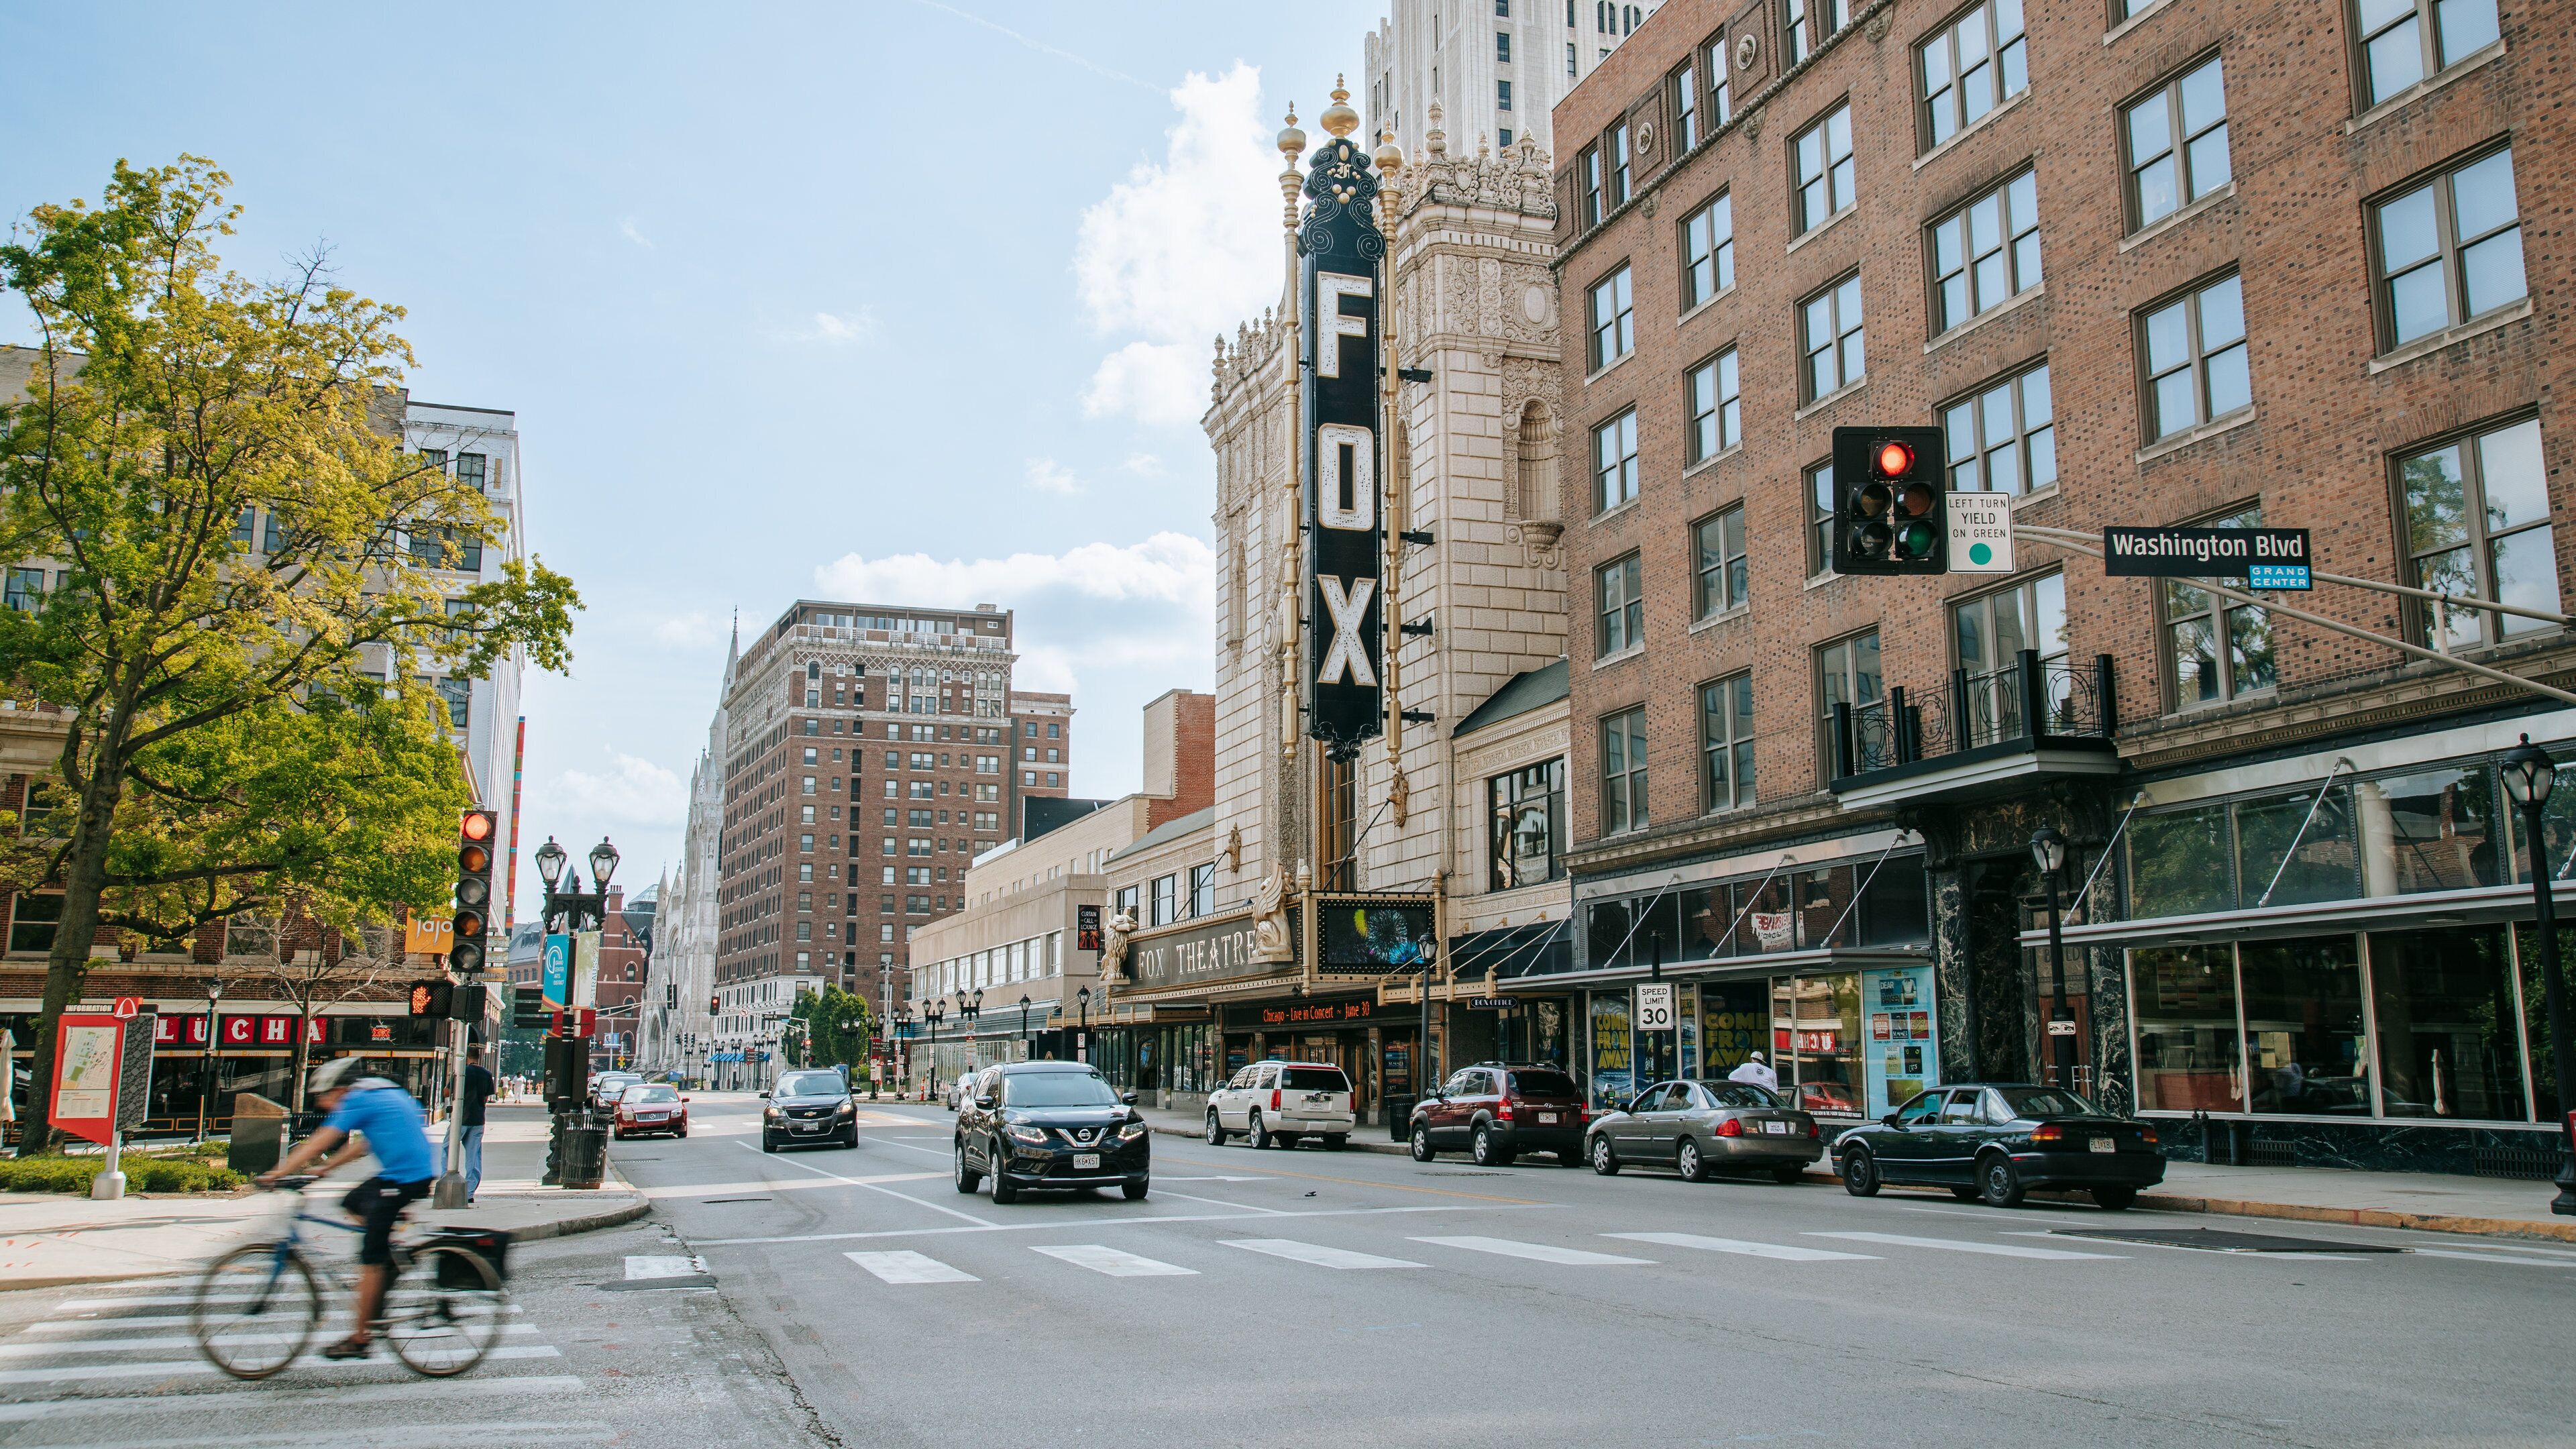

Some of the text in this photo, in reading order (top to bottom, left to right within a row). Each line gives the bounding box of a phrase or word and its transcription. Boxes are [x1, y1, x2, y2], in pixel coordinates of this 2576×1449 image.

[1316, 272, 1377, 687] FOX
[1949, 499, 2006, 508] LEFT TURN
[1961, 513, 1996, 524] YIELD
[1953, 529, 2006, 537] ON GREEN
[2112, 533, 2302, 561] Washington Blvd
[2251, 567, 2306, 576] GRAND
[2253, 578, 2306, 586] CENTER
[1138, 930, 1256, 981] FOX THEATRE
[1263, 1008, 1285, 1024] Chicago
[1291, 1007, 1302, 1021] Live
[1303, 1006, 1309, 1020] in
[1310, 1006, 1334, 1020] Concert
[1345, 1003, 1359, 1020] June
[1361, 1001, 1370, 1016] 30
[1597, 1012, 1628, 1031] COME
[1642, 1008, 1668, 1025] 30
[1705, 1012, 1769, 1030] COME
[1597, 1031, 1629, 1049] FROM
[1705, 1030, 1770, 1048] FROM
[1597, 1050, 1629, 1069] AWAY
[1909, 1064, 1918, 1072] CATS
